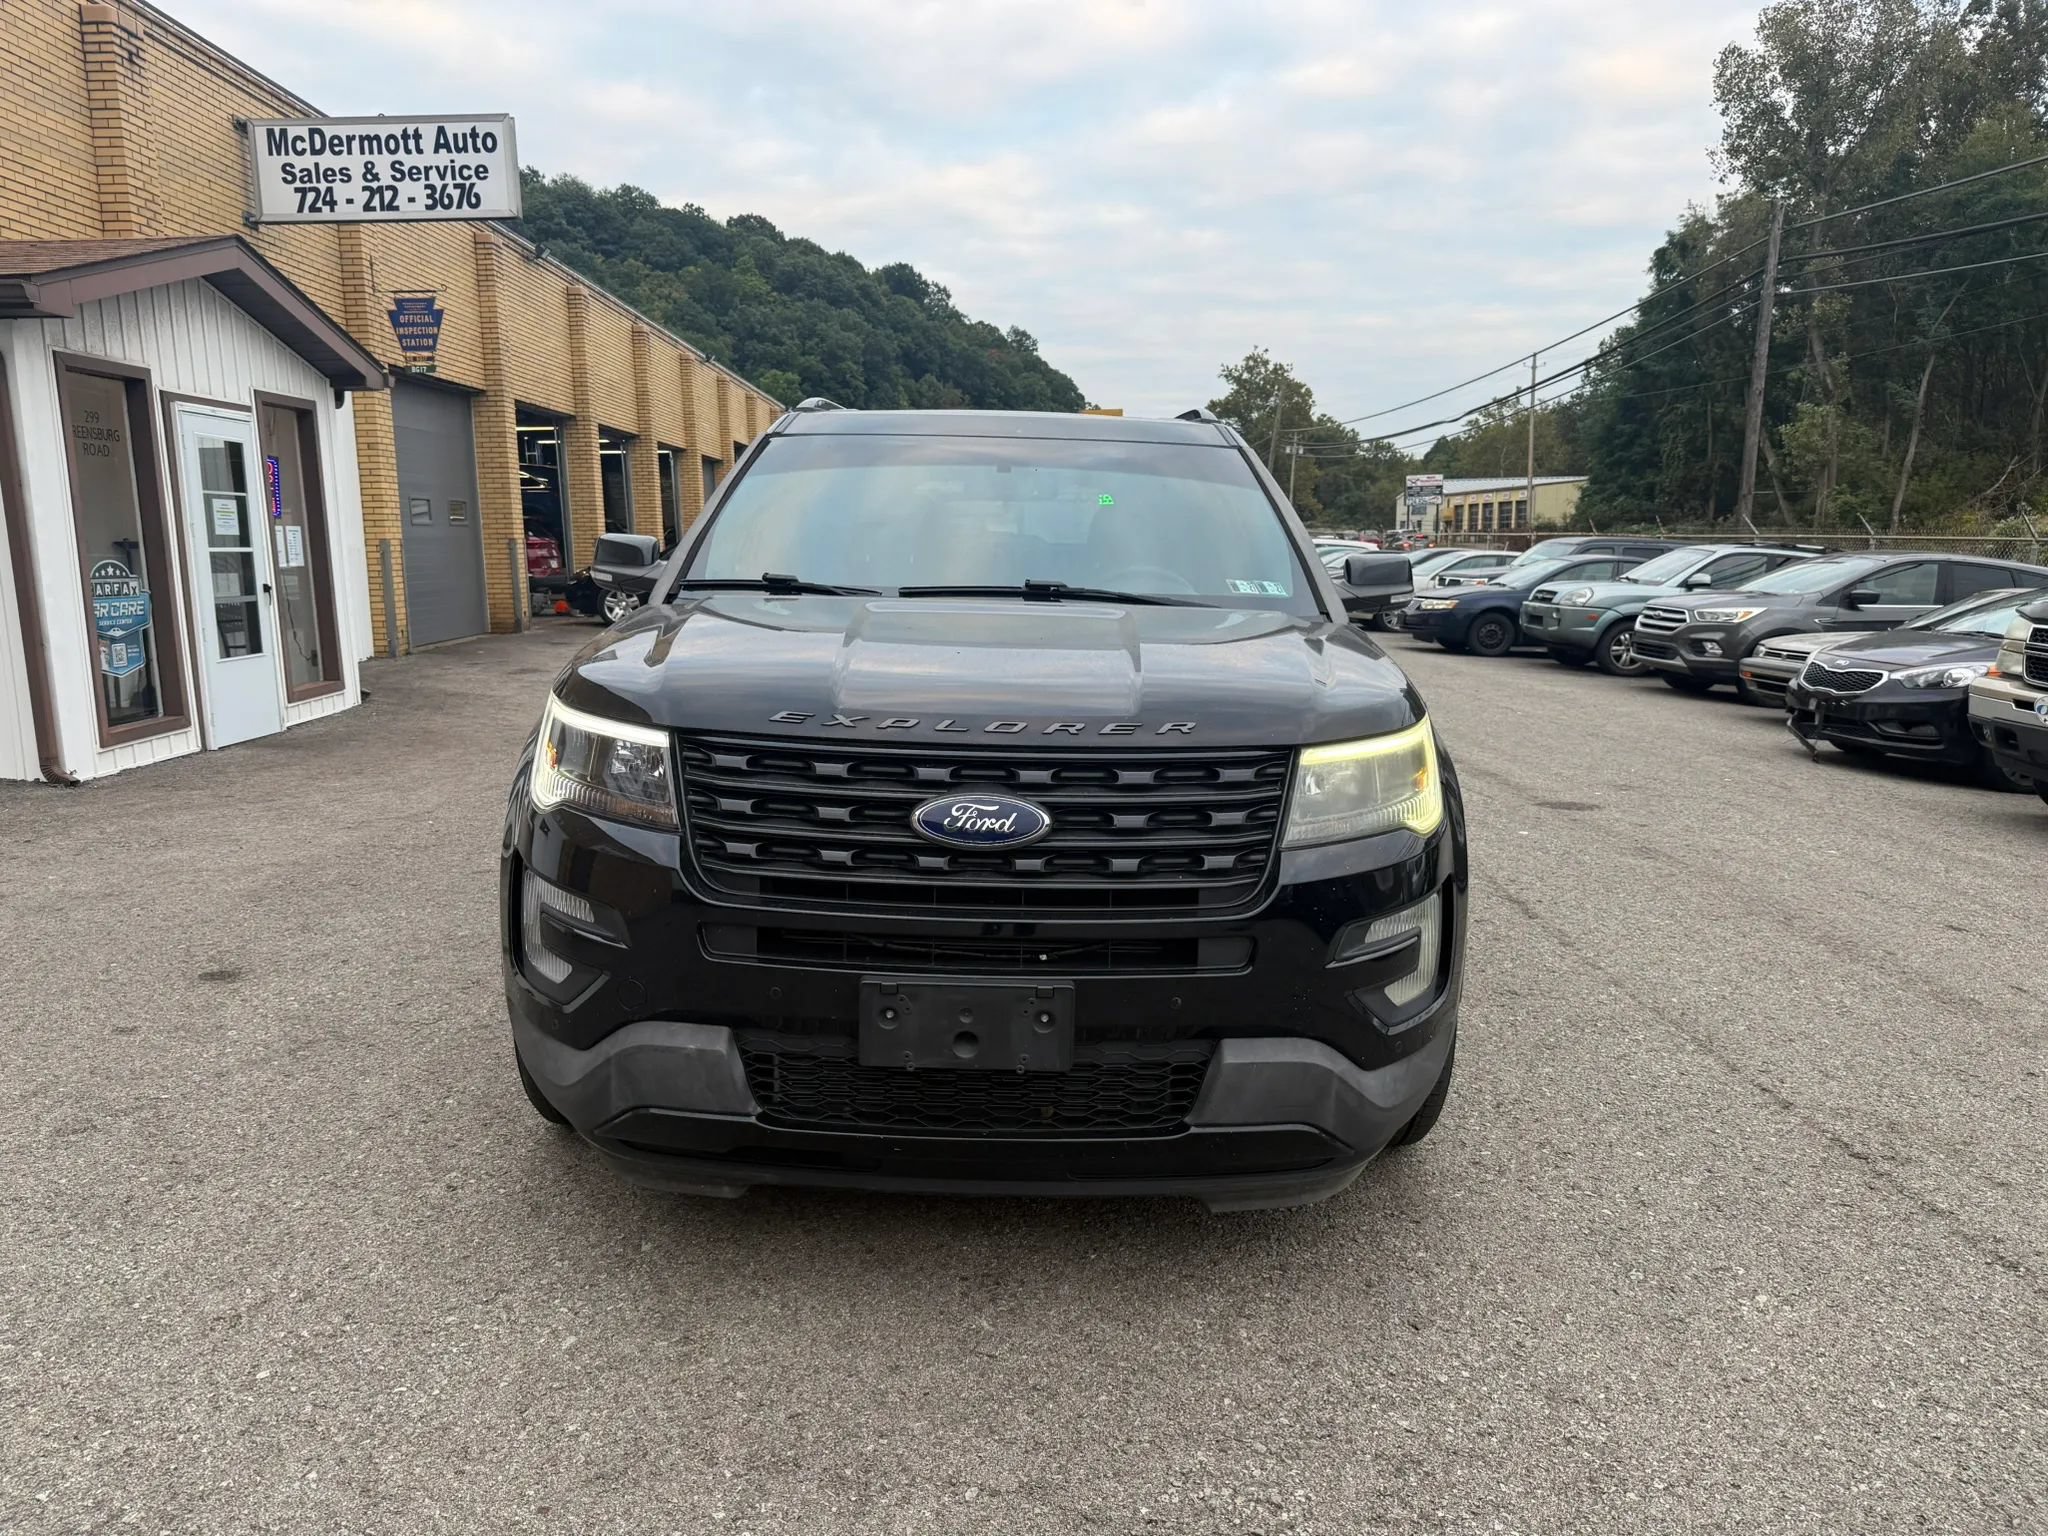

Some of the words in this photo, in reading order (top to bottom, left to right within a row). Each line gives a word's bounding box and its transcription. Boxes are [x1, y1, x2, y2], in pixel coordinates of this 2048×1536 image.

[266, 126, 424, 156] McDermott
[433, 125, 498, 155] Auto
[281, 162, 352, 185] Sales
[362, 160, 381, 183] &
[390, 159, 489, 182] Service
[294, 186, 338, 213] 724
[362, 185, 400, 212] 212
[424, 183, 481, 211] 3676
[400, 315, 434, 323] OFFICIAL
[396, 326, 438, 335] INSPECTION
[402, 338, 433, 347] STATION
[84, 410, 100, 423] 299
[72, 424, 120, 442] REENSBURG
[83, 442, 110, 457] ROAD
[92, 582, 139, 596] ARFAX
[93, 602, 109, 617] AR
[111, 601, 144, 616] CARE
[768, 710, 1198, 736] EXPLORER
[943, 803, 1016, 834] Ford
